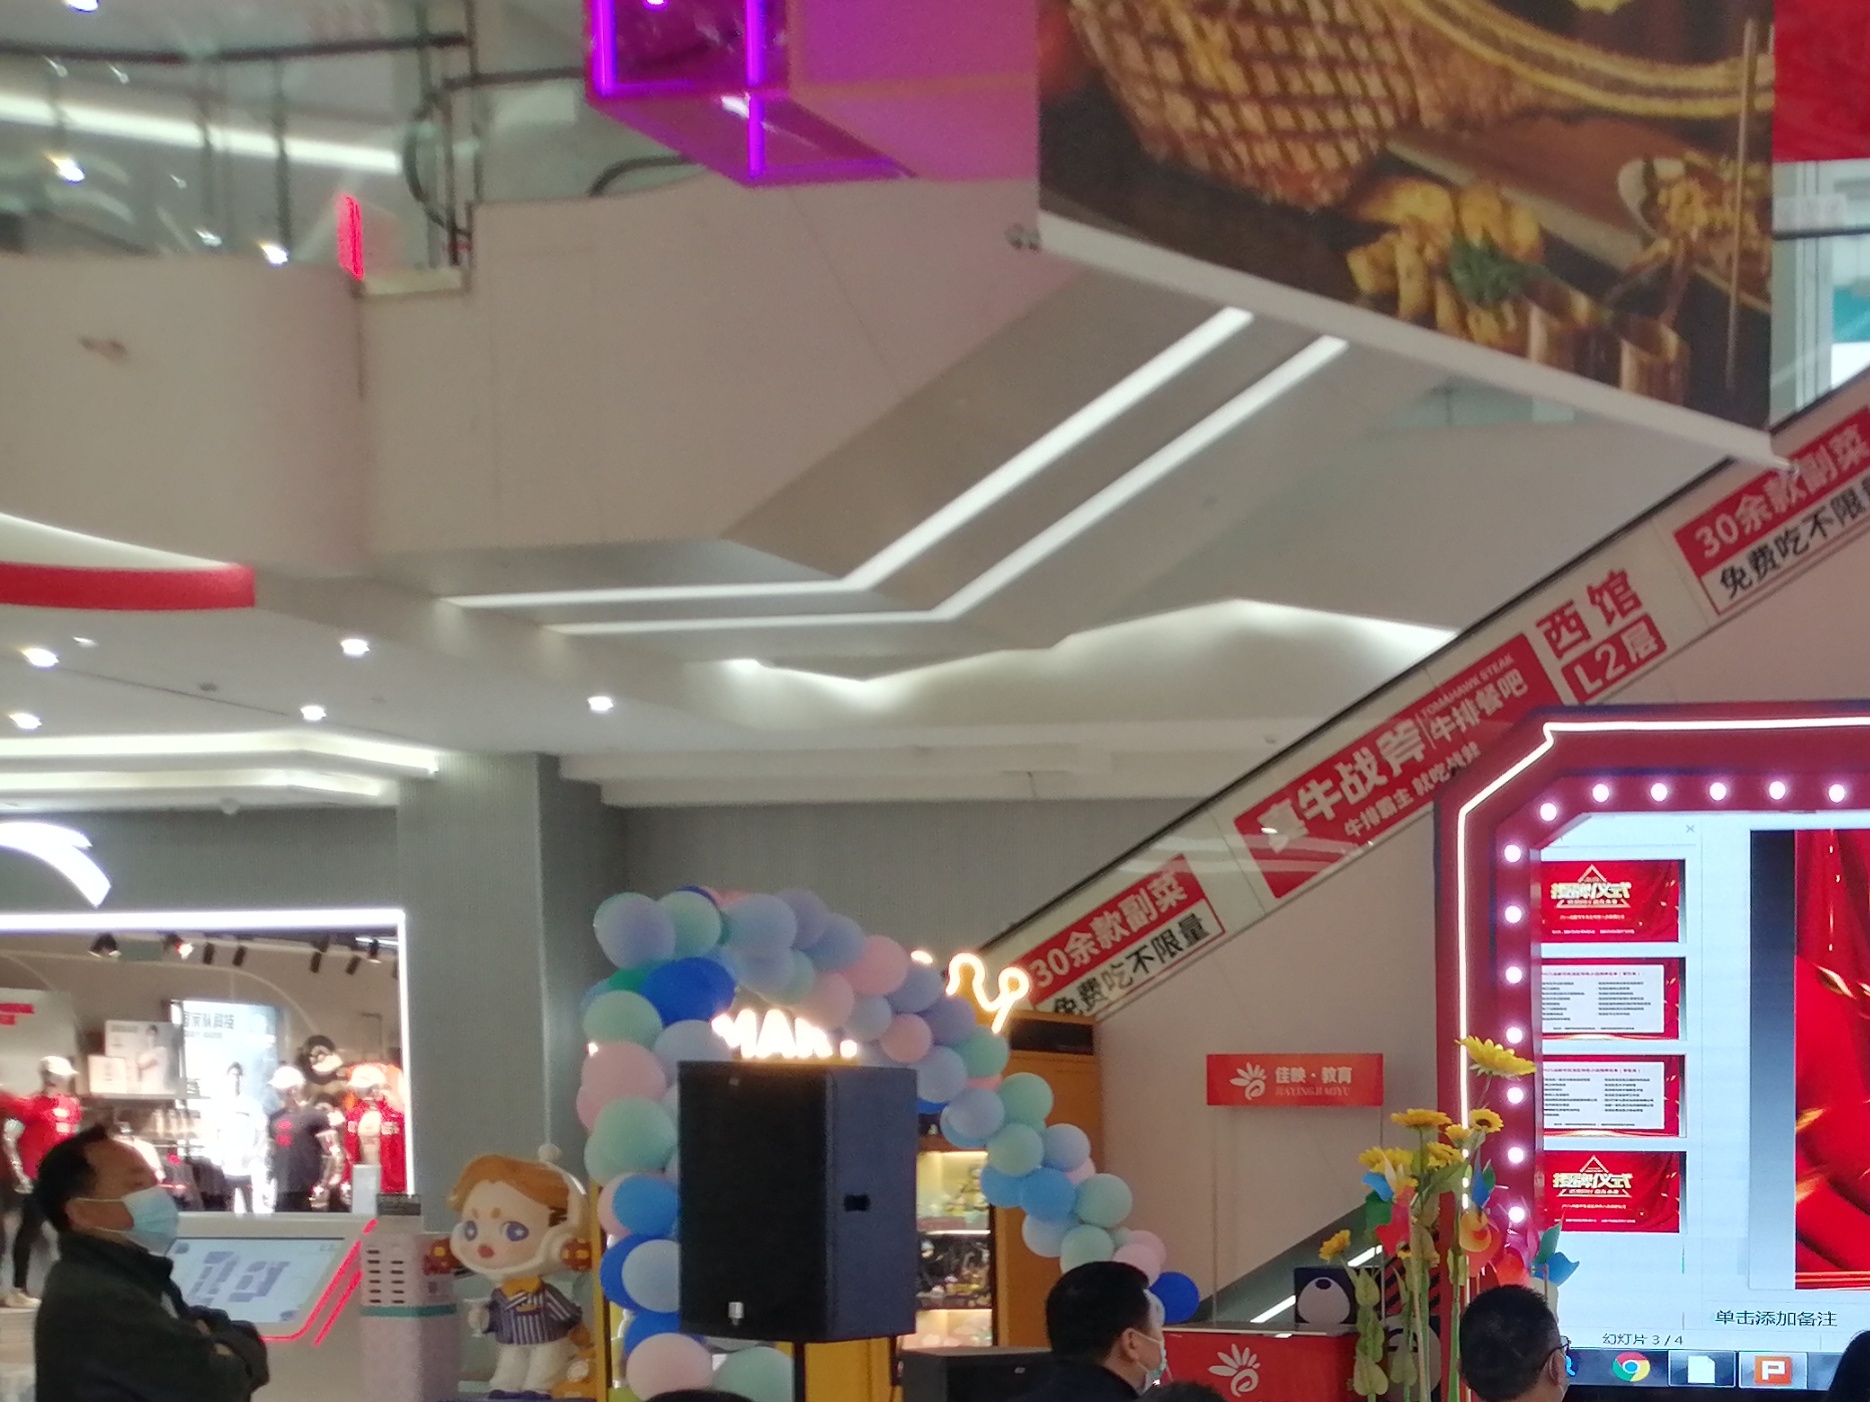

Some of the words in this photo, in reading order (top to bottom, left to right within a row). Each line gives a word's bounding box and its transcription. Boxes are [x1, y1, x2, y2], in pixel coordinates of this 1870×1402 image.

[1536, 568, 1643, 660] 西馆
[1573, 627, 1659, 695] L2层
[1430, 668, 1529, 742] 牛排餐吧
[1030, 870, 1187, 988] 30余款副菜
[1053, 913, 1211, 1017] 免费吃不限量
[1714, 1310, 1838, 1328] 单击添加备注
